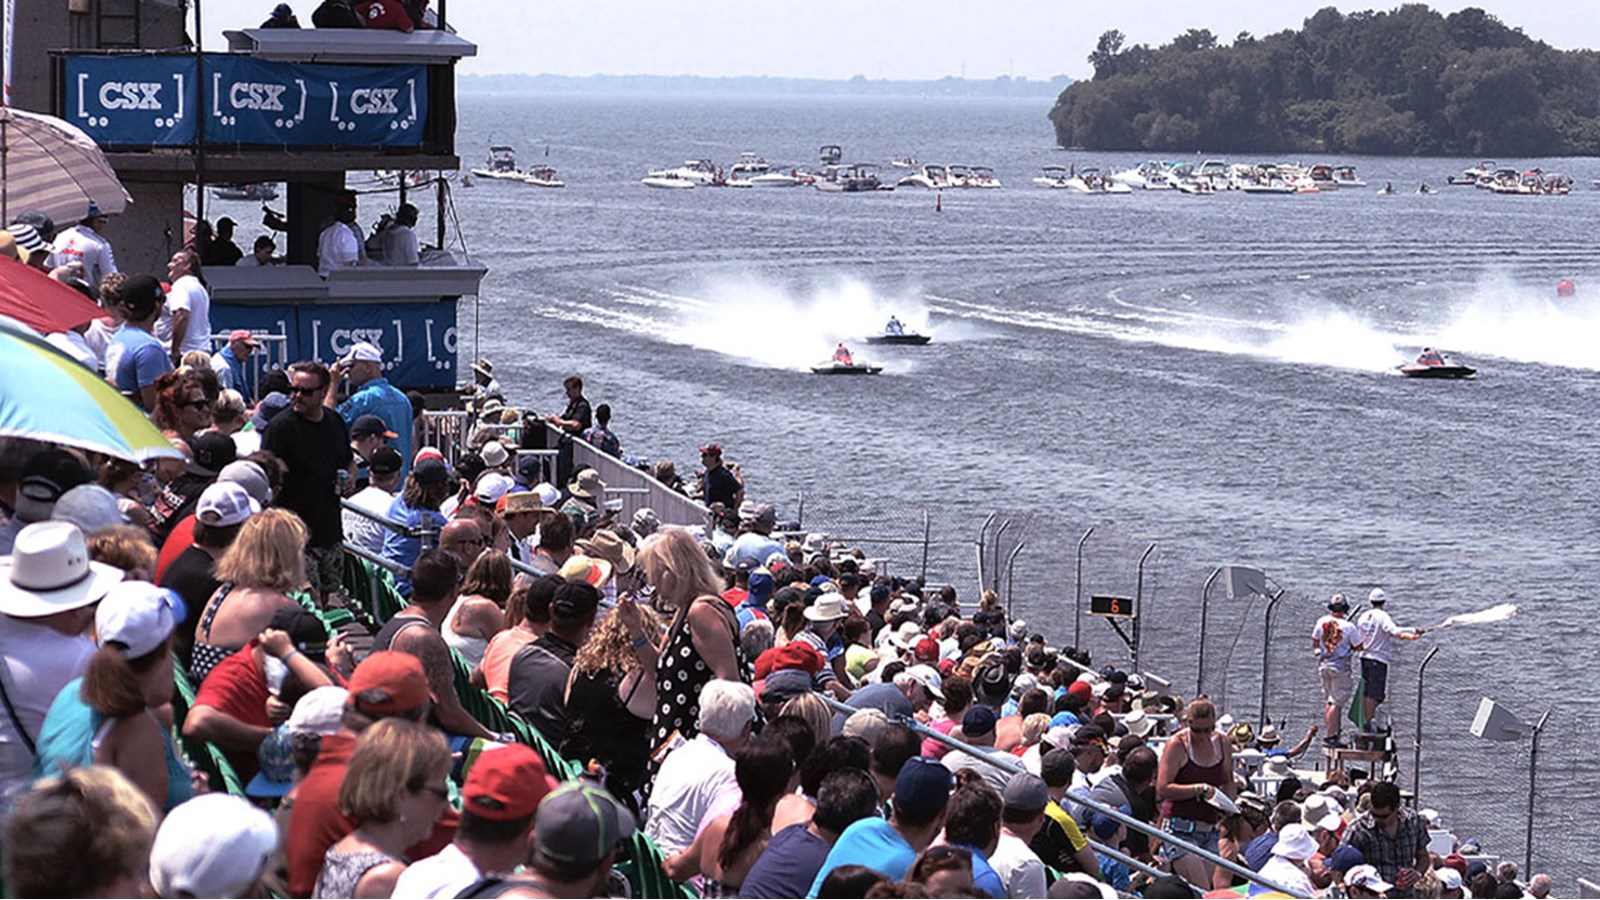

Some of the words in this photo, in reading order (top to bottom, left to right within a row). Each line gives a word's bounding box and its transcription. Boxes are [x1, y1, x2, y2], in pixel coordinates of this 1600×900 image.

[99, 82, 162, 109] CSX
[230, 82, 286, 111] CSX
[350, 88, 399, 114] CSX
[1111, 598, 1120, 614] 6
